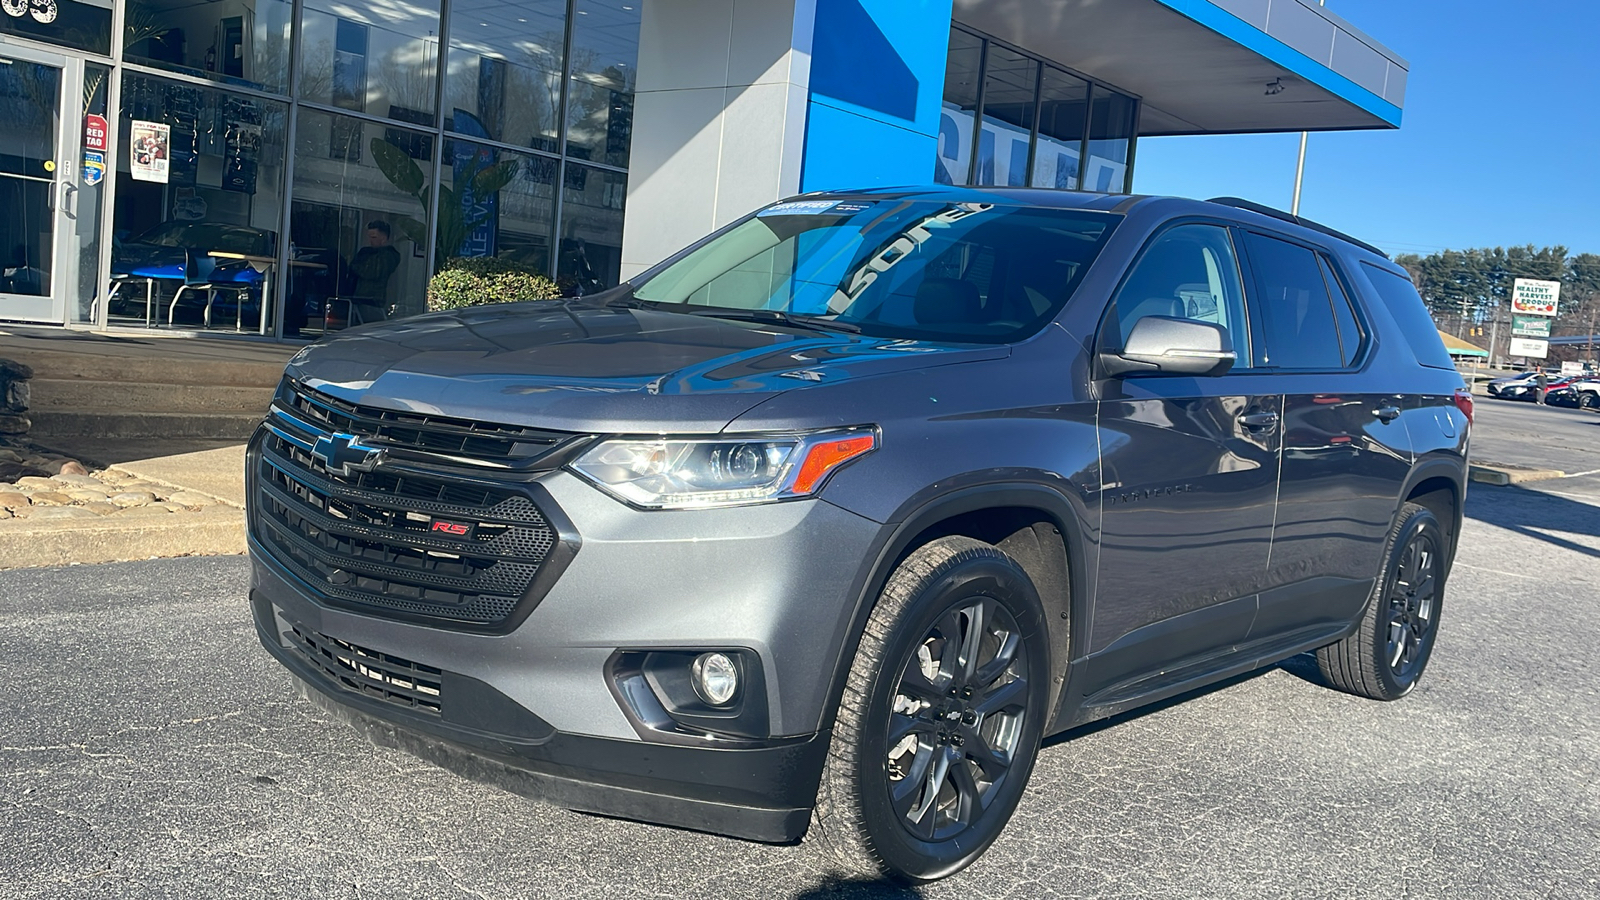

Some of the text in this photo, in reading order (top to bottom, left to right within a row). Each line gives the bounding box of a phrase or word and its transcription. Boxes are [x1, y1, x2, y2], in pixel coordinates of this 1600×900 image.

[86, 127, 104, 137] RED
[86, 136, 102, 147] TAG
[1516, 286, 1550, 294] HEALTHY
[1519, 292, 1553, 300] HARVEST
[1521, 298, 1556, 306] PRODUCE
[432, 521, 469, 535] RS
